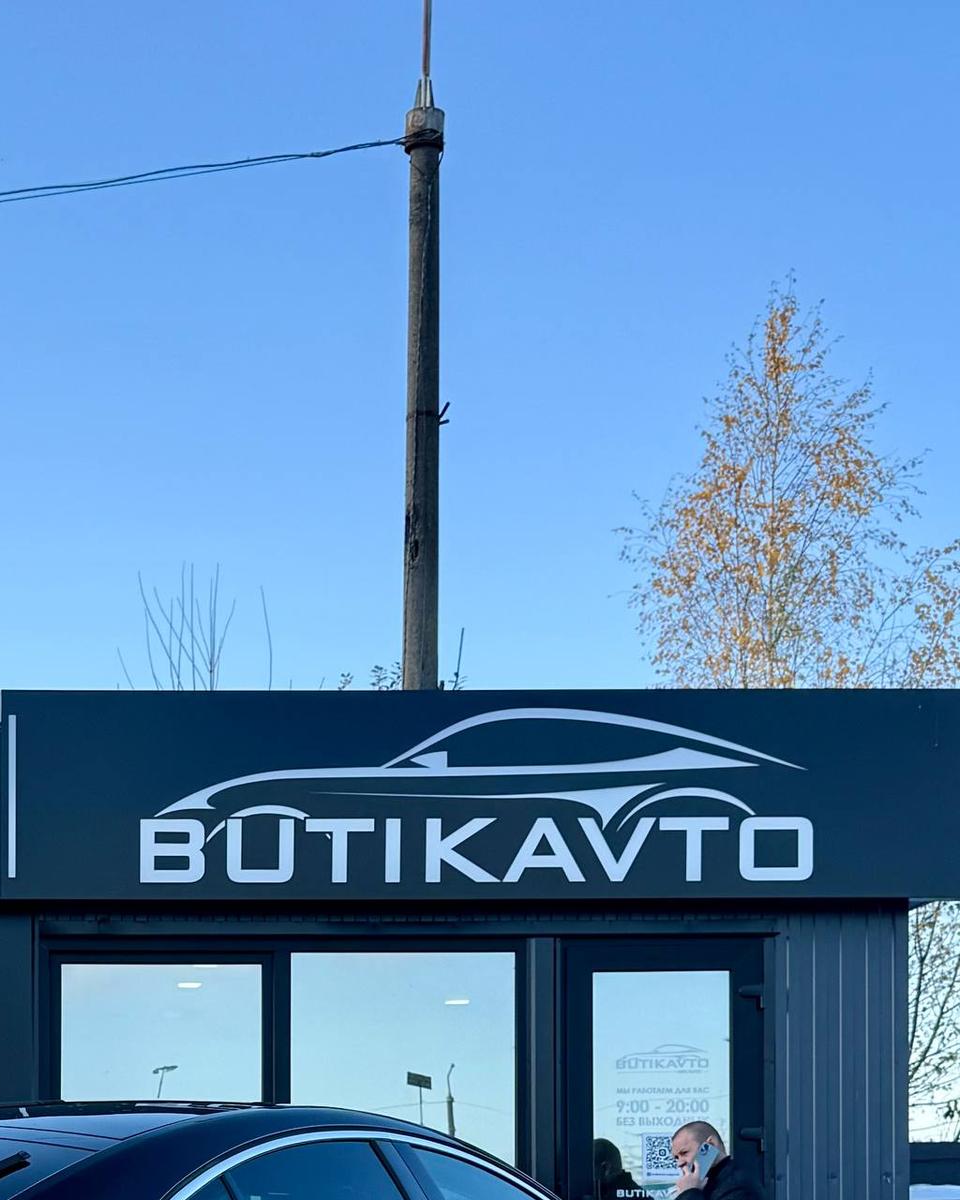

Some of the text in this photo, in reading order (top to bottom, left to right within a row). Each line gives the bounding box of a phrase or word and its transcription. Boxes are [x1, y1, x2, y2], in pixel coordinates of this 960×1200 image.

[140, 816, 814, 884] BUTIKAVTO
[616, 1058, 709, 1069] BUTIKAVTO
[616, 1100, 649, 1113] 9:00
[666, 1100, 710, 1113] 20:00
[616, 1117, 636, 1126] БЕЗ
